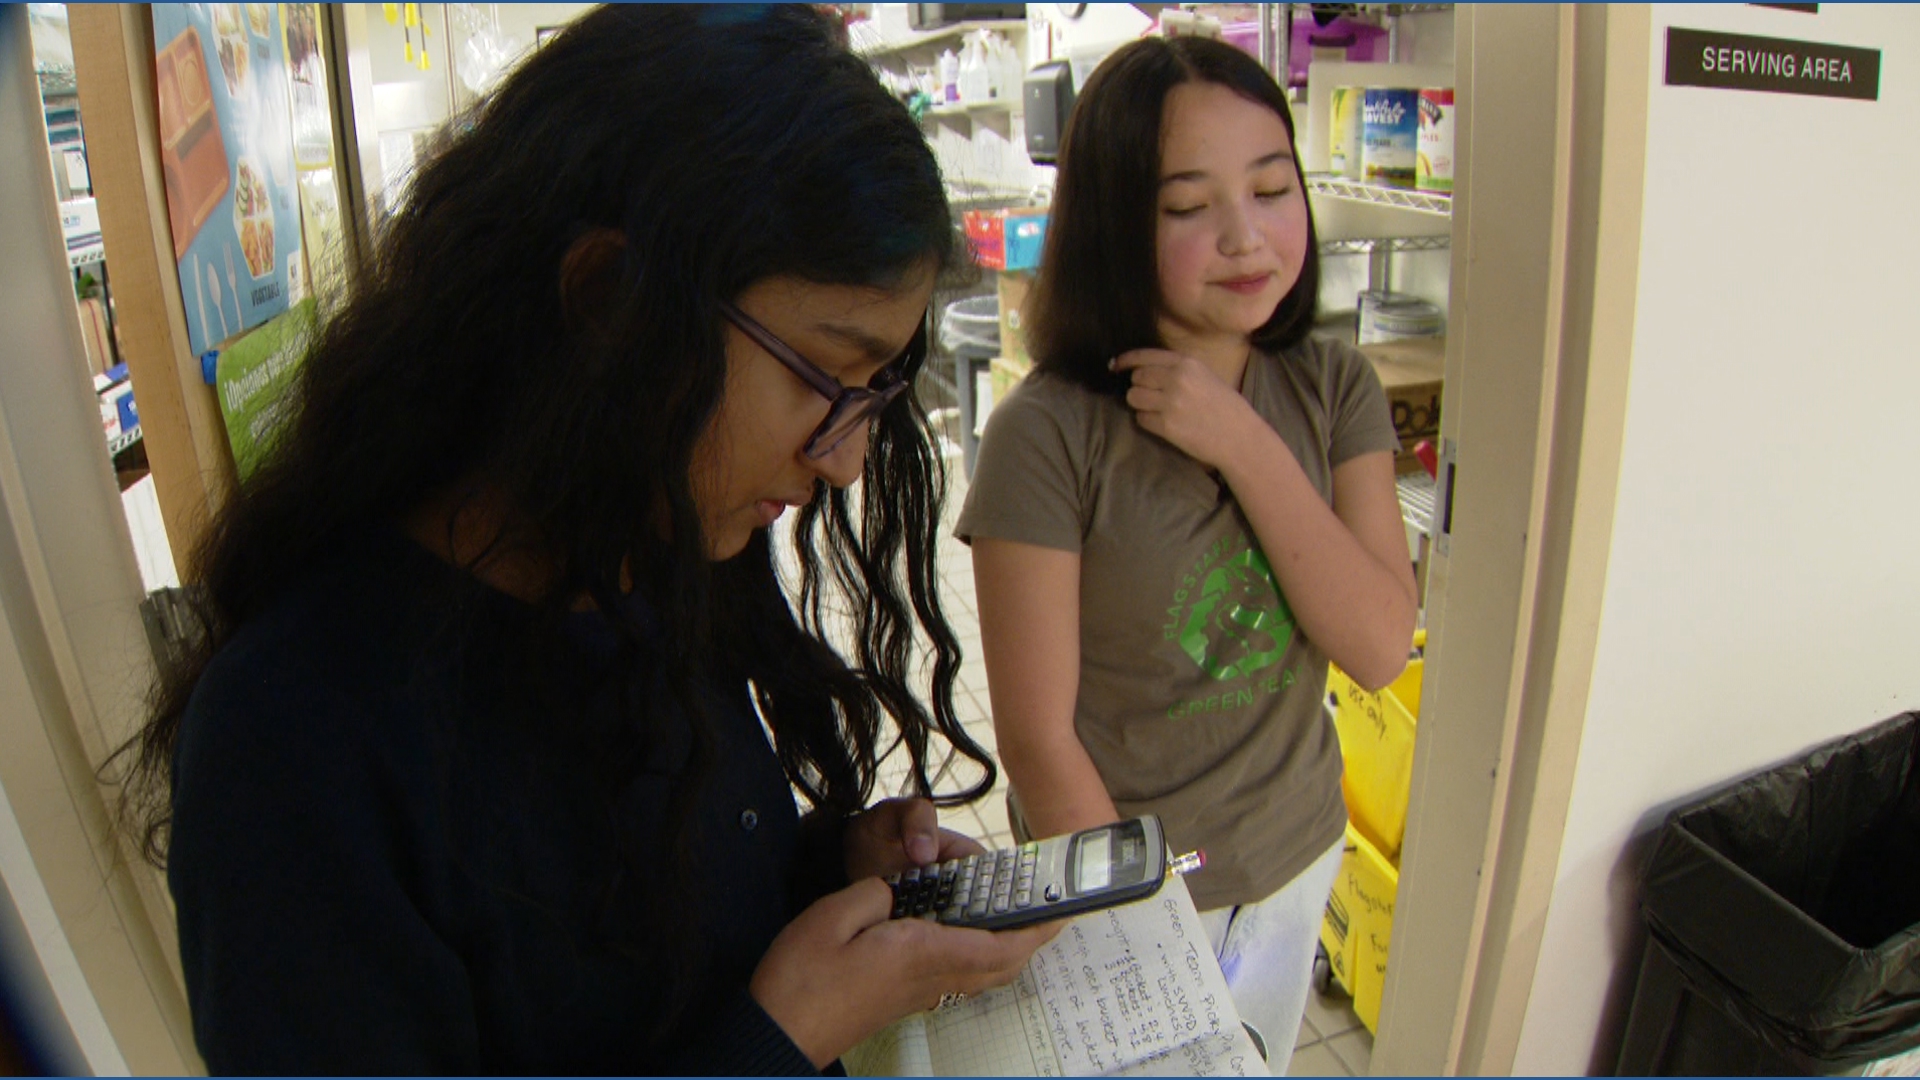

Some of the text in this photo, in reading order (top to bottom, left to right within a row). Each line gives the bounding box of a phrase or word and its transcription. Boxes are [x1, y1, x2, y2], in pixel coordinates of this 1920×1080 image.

[1701, 46, 1853, 83] SERVING AREA
[1167, 686, 1254, 721] GREEN
